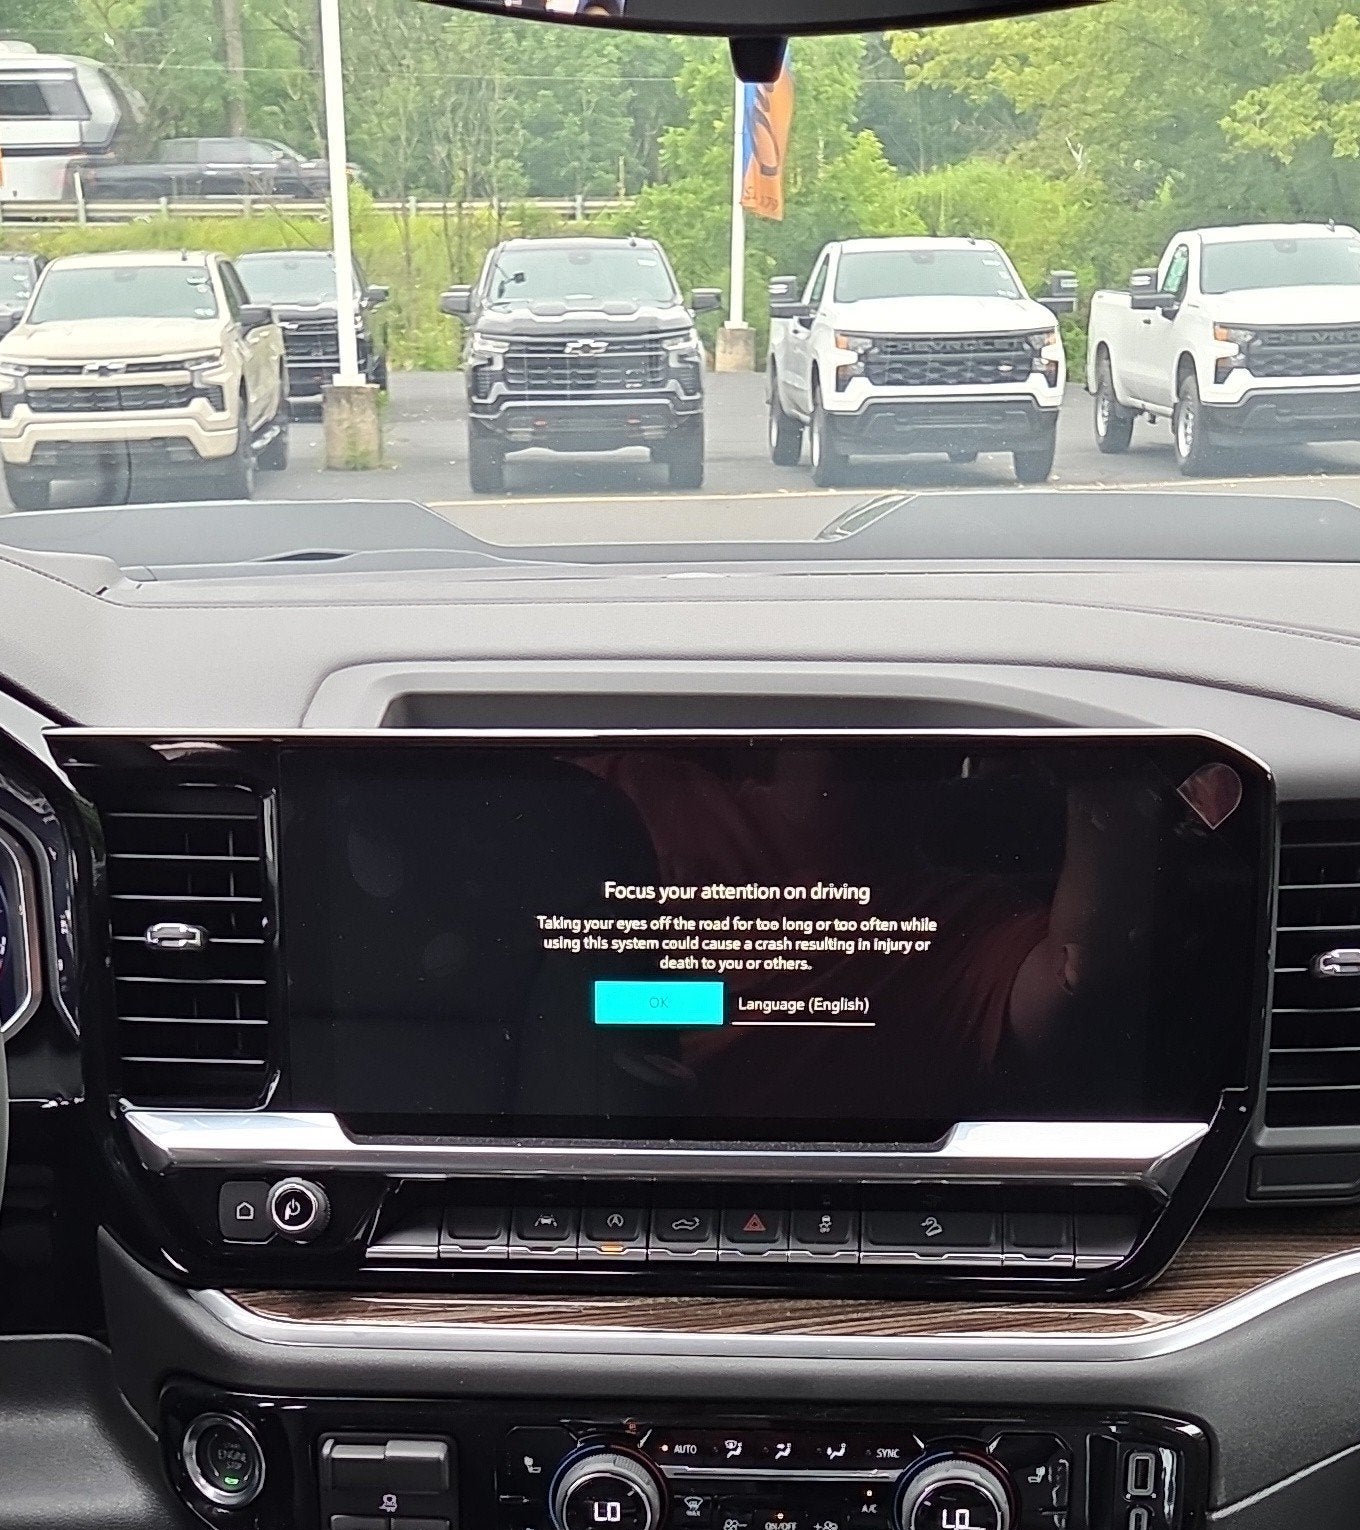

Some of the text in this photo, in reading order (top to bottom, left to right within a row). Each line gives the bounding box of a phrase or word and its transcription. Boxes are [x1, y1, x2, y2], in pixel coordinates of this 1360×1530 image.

[604, 881, 871, 905] Focus your attention on driving
[536, 915, 938, 934] Taking your eyes off the road for too long or too often while
[543, 935, 931, 954] using this system could cause a crash resulting in injury or
[659, 955, 813, 974] death to you or others.
[648, 994, 670, 1010] OK
[738, 997, 870, 1014] Language (English)
[673, 1444, 698, 1455] AUTO
[875, 1447, 901, 1460] SYNC
